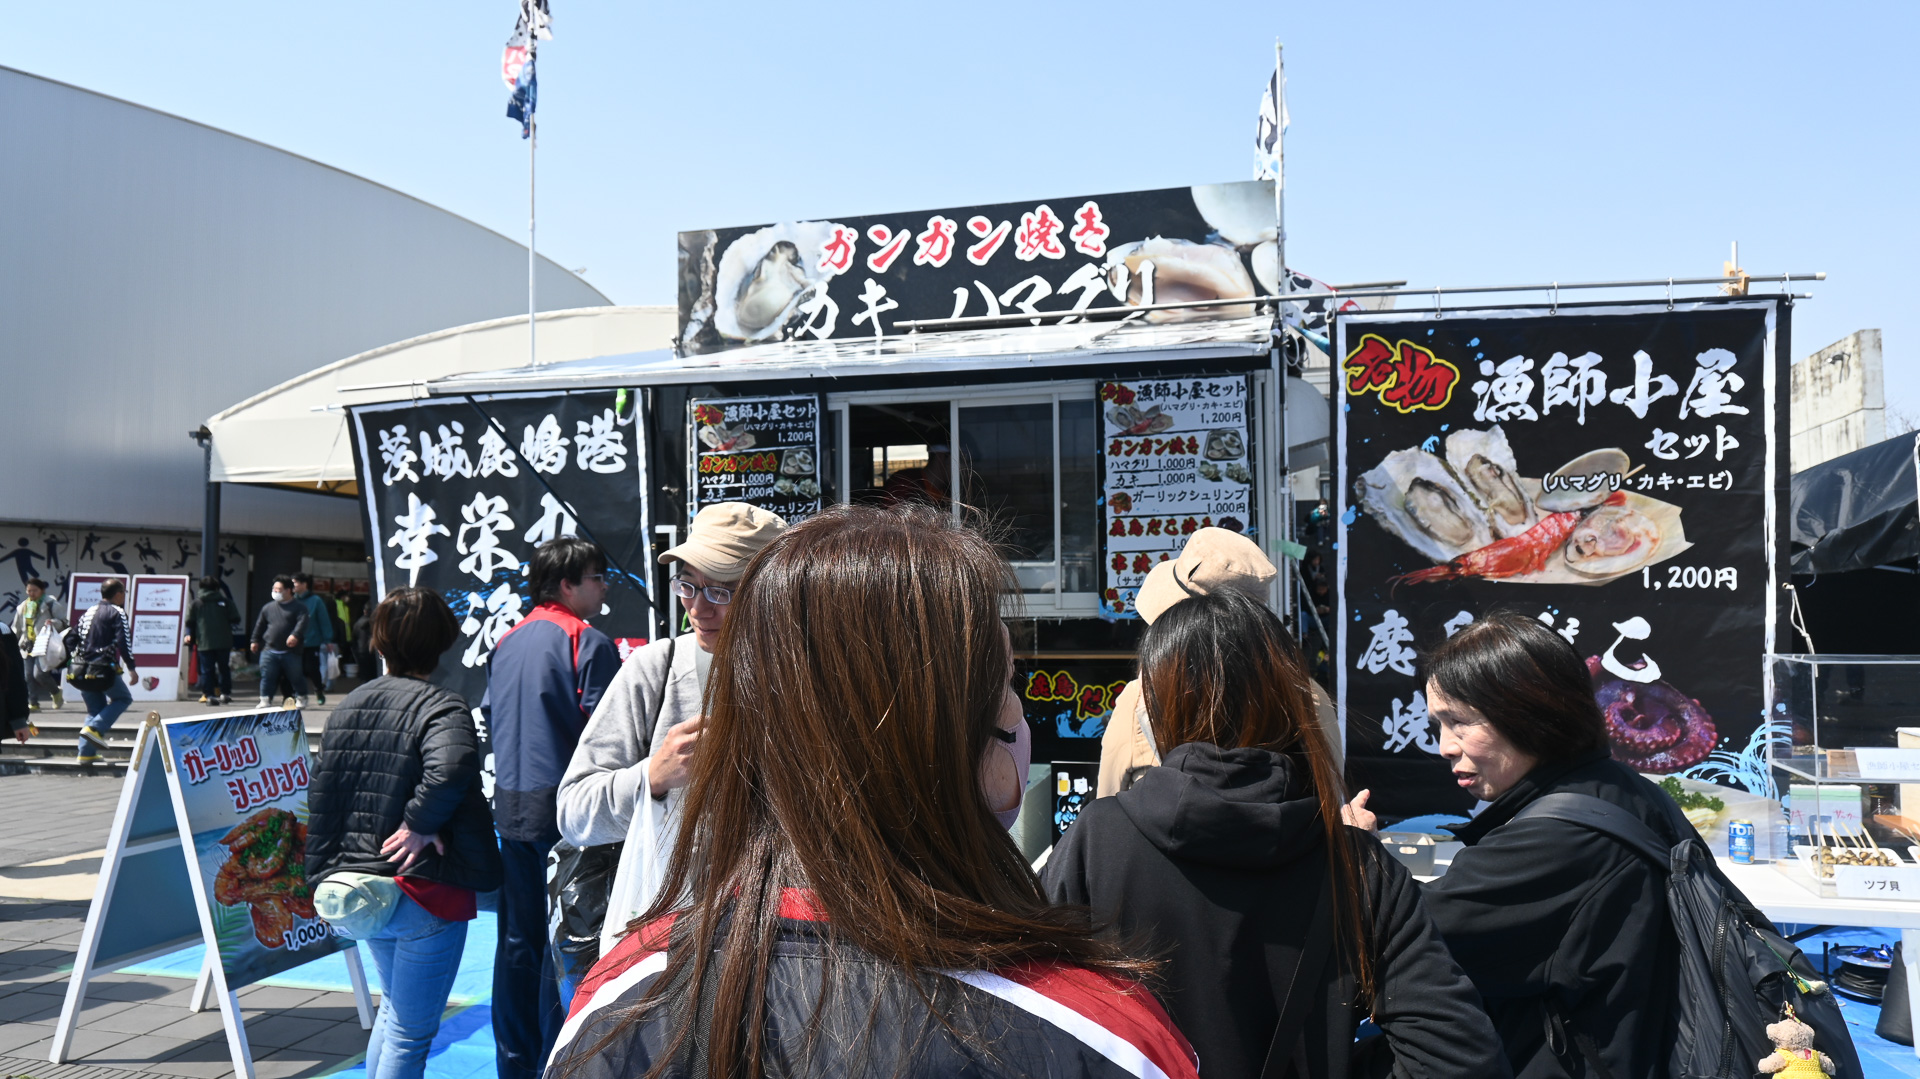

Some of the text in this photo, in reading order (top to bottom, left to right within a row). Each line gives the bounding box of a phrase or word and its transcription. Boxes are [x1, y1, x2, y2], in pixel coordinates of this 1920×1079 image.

[817, 201, 1111, 275] ガンガン焼き
[950, 260, 1157, 325] ハマグリ
[795, 279, 899, 339] カキ
[1344, 333, 1460, 413] 名物
[1137, 381, 1246, 402] 漁師小屋セット
[1472, 349, 1750, 424] 漁師小屋
[724, 402, 817, 422] 漁師小屋セット
[1201, 412, 1242, 424] 1,200円
[1108, 435, 1199, 457] ガンガン焼き
[1645, 426, 1740, 462] セット
[1110, 459, 1149, 470] ハマグリ
[701, 474, 735, 484] ハマグリ
[1116, 475, 1139, 487] カキ
[1542, 470, 1733, 493] (ハマグリ・カキ・エビ)
[1641, 567, 1738, 592] 1,200円
[183, 737, 259, 783] ガーリック
[226, 756, 309, 811] シュリンプ
[284, 923, 335, 950] 1,000
